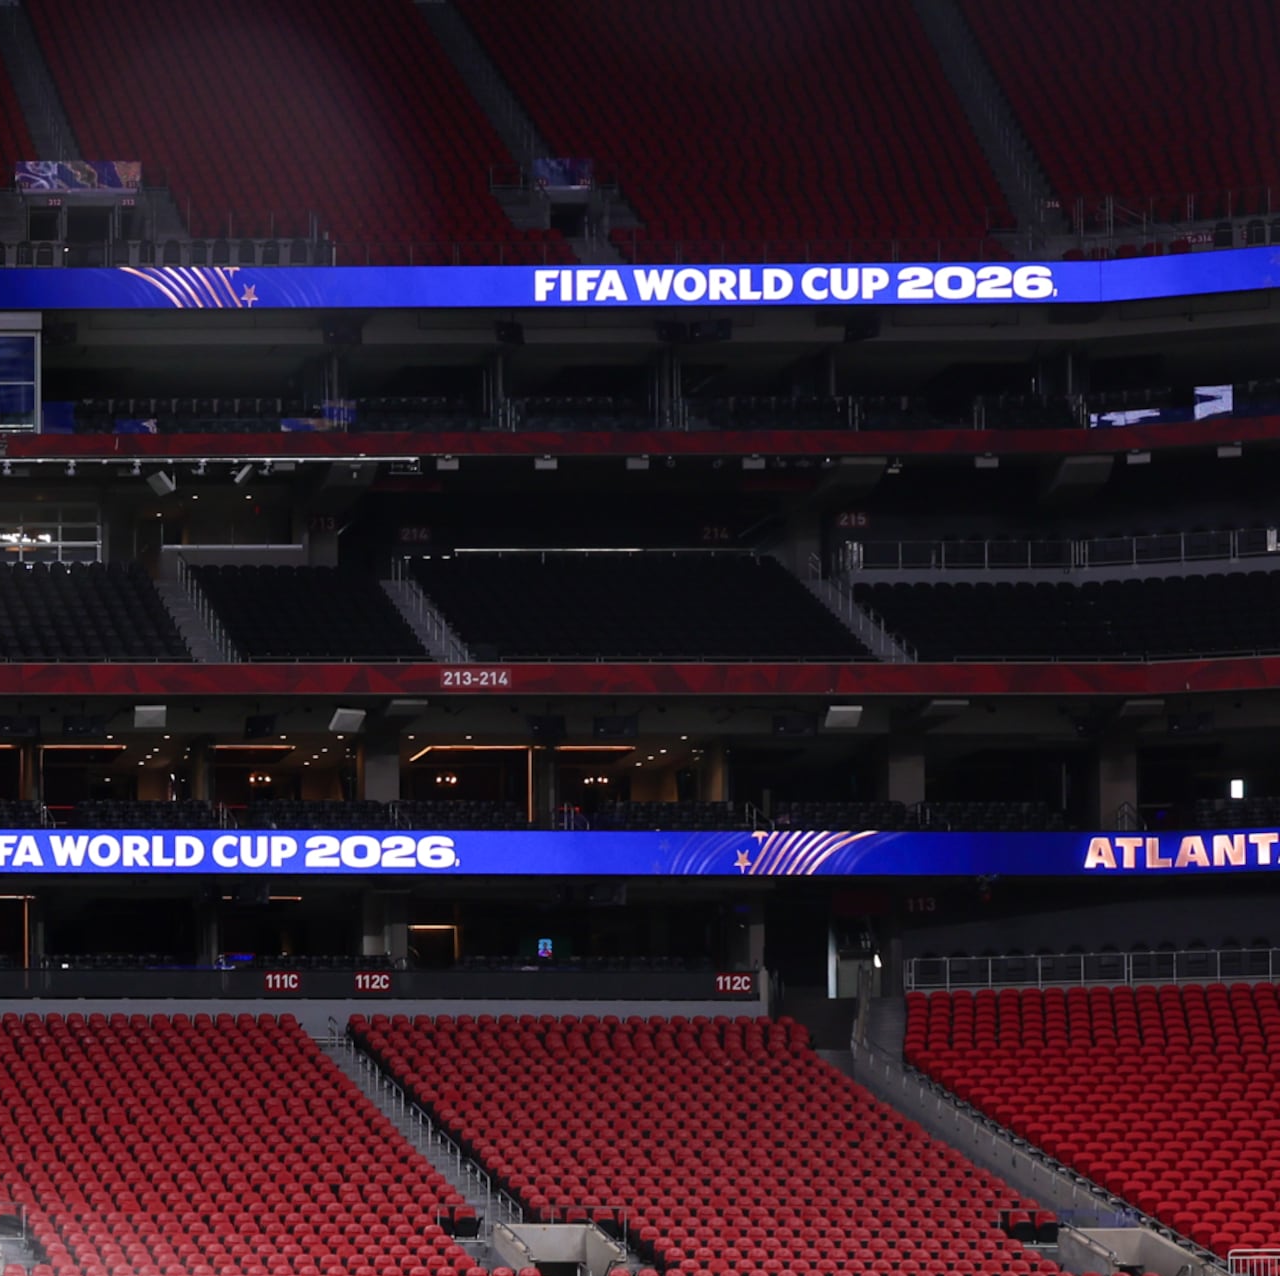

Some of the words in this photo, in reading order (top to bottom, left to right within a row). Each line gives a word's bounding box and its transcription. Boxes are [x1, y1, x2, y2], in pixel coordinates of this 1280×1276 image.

[534, 269, 628, 302] FIFA
[632, 268, 794, 302] WORLD
[800, 267, 890, 301] CUP
[896, 265, 1053, 300] 2026
[839, 512, 866, 527] 215
[400, 527, 428, 541] 214
[703, 527, 729, 540] 214
[443, 671, 509, 686] 213-214
[48, 834, 205, 868] WORLD
[211, 835, 298, 868] CUP
[303, 835, 454, 868] 2026
[1084, 832, 1280, 869] ATLANT
[906, 896, 937, 912] 113
[265, 973, 299, 989] 111C
[354, 973, 390, 989] 112C
[716, 975, 751, 991] 112C
